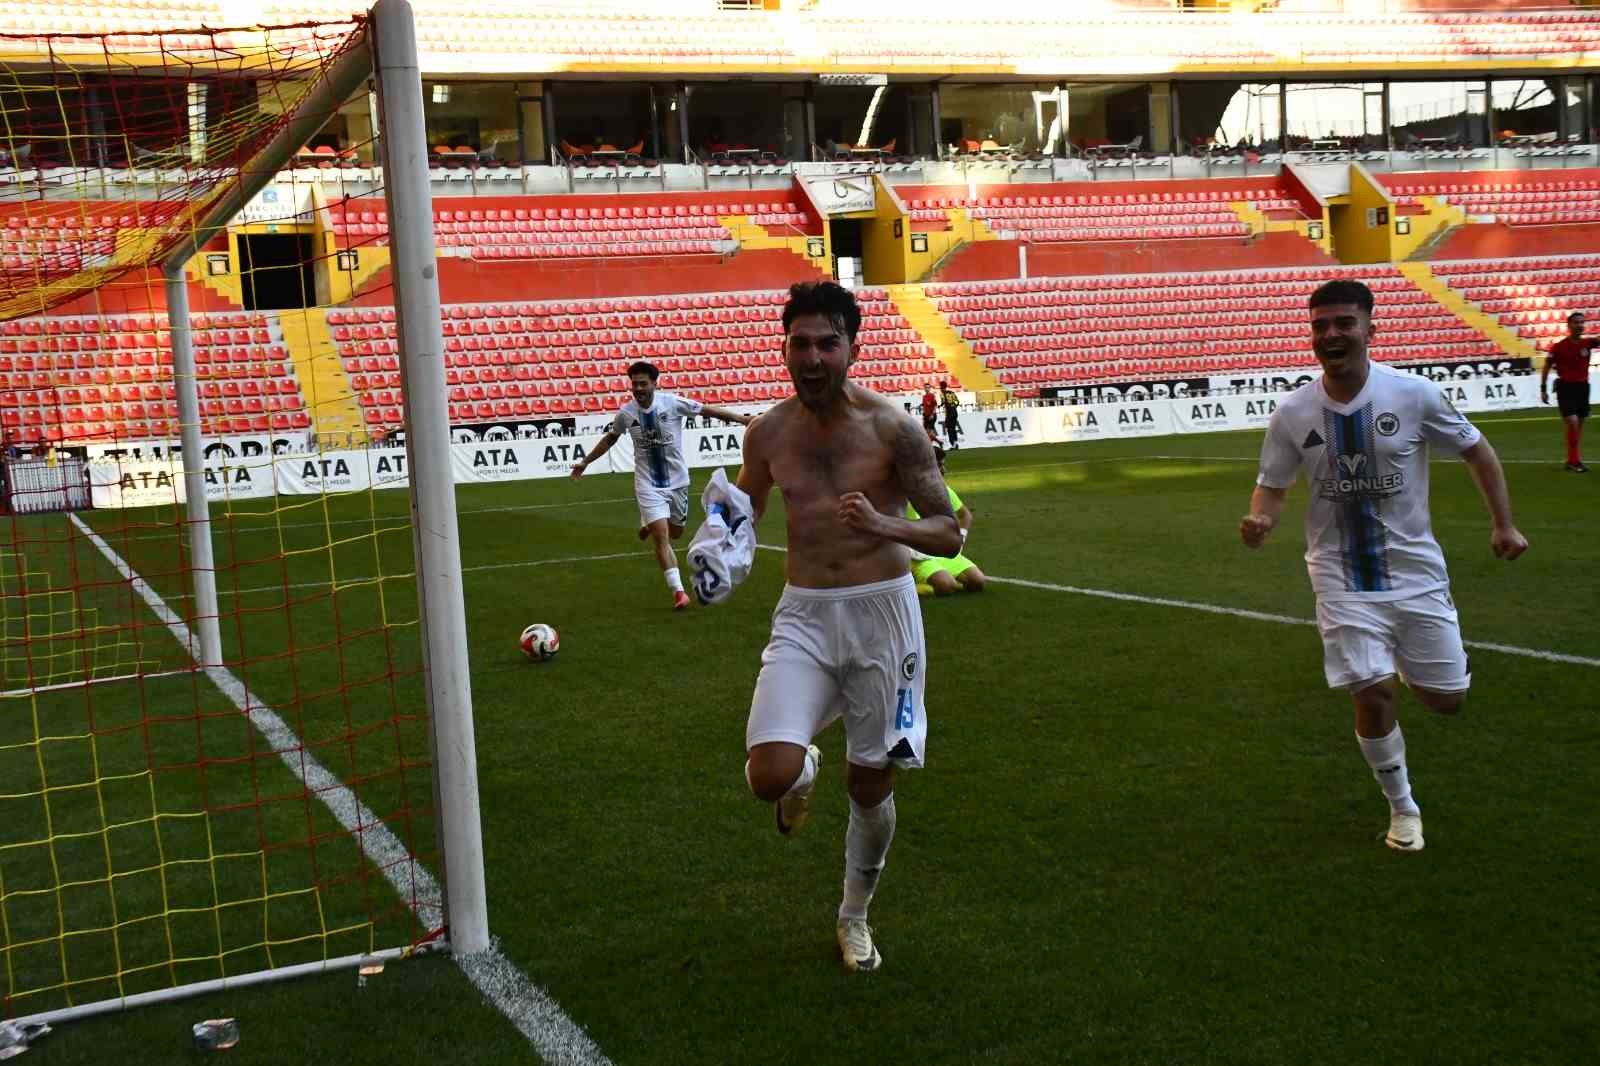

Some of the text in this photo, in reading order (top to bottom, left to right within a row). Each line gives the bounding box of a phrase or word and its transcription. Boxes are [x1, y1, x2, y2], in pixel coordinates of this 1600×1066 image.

[1485, 384, 1517, 399] ATA
[1063, 411, 1098, 428] ATA
[1118, 408, 1154, 424] ATA
[1191, 403, 1226, 419] ATA
[985, 416, 1022, 433] ATA
[699, 434, 740, 452] ATA
[474, 449, 519, 466] ATA
[543, 444, 587, 462] ATA
[302, 459, 350, 478] ATA
[376, 455, 405, 473] AT
[121, 470, 172, 490] ATA
[204, 466, 252, 485] ATA
